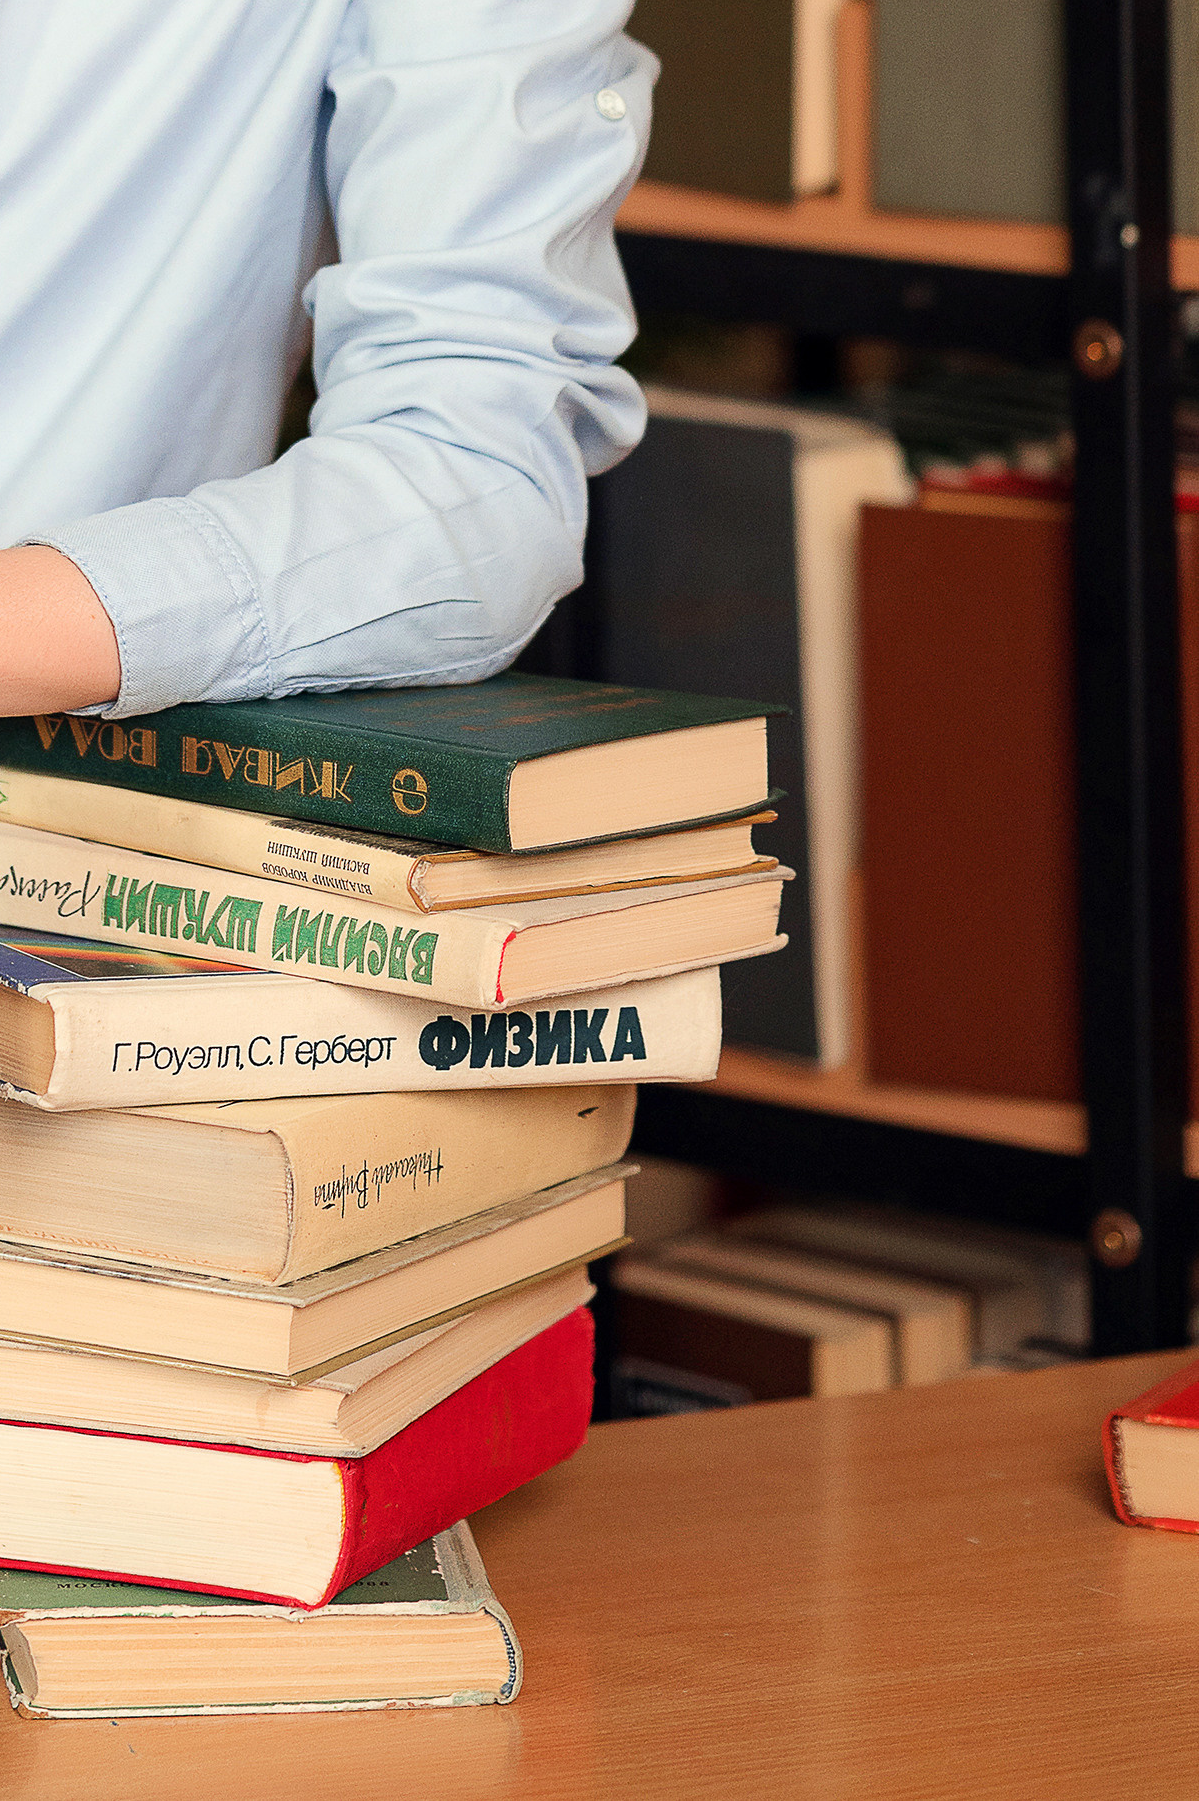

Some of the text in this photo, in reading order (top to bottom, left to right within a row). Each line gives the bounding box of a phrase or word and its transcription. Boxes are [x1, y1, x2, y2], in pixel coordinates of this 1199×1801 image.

[33, 715, 354, 803] ЖИВАЯ ВОДА
[261, 861, 374, 896] ВЛАДИМИР КОРОБОВ
[266, 840, 371, 876] ВАСИЛИЙ ШУКШИН
[101, 872, 264, 953] ШУКШИН
[271, 903, 440, 986] ВАСИЛИЙ
[418, 1006, 648, 1071] ФИЗИКА
[313, 1146, 444, 1219] Николай Вирта
